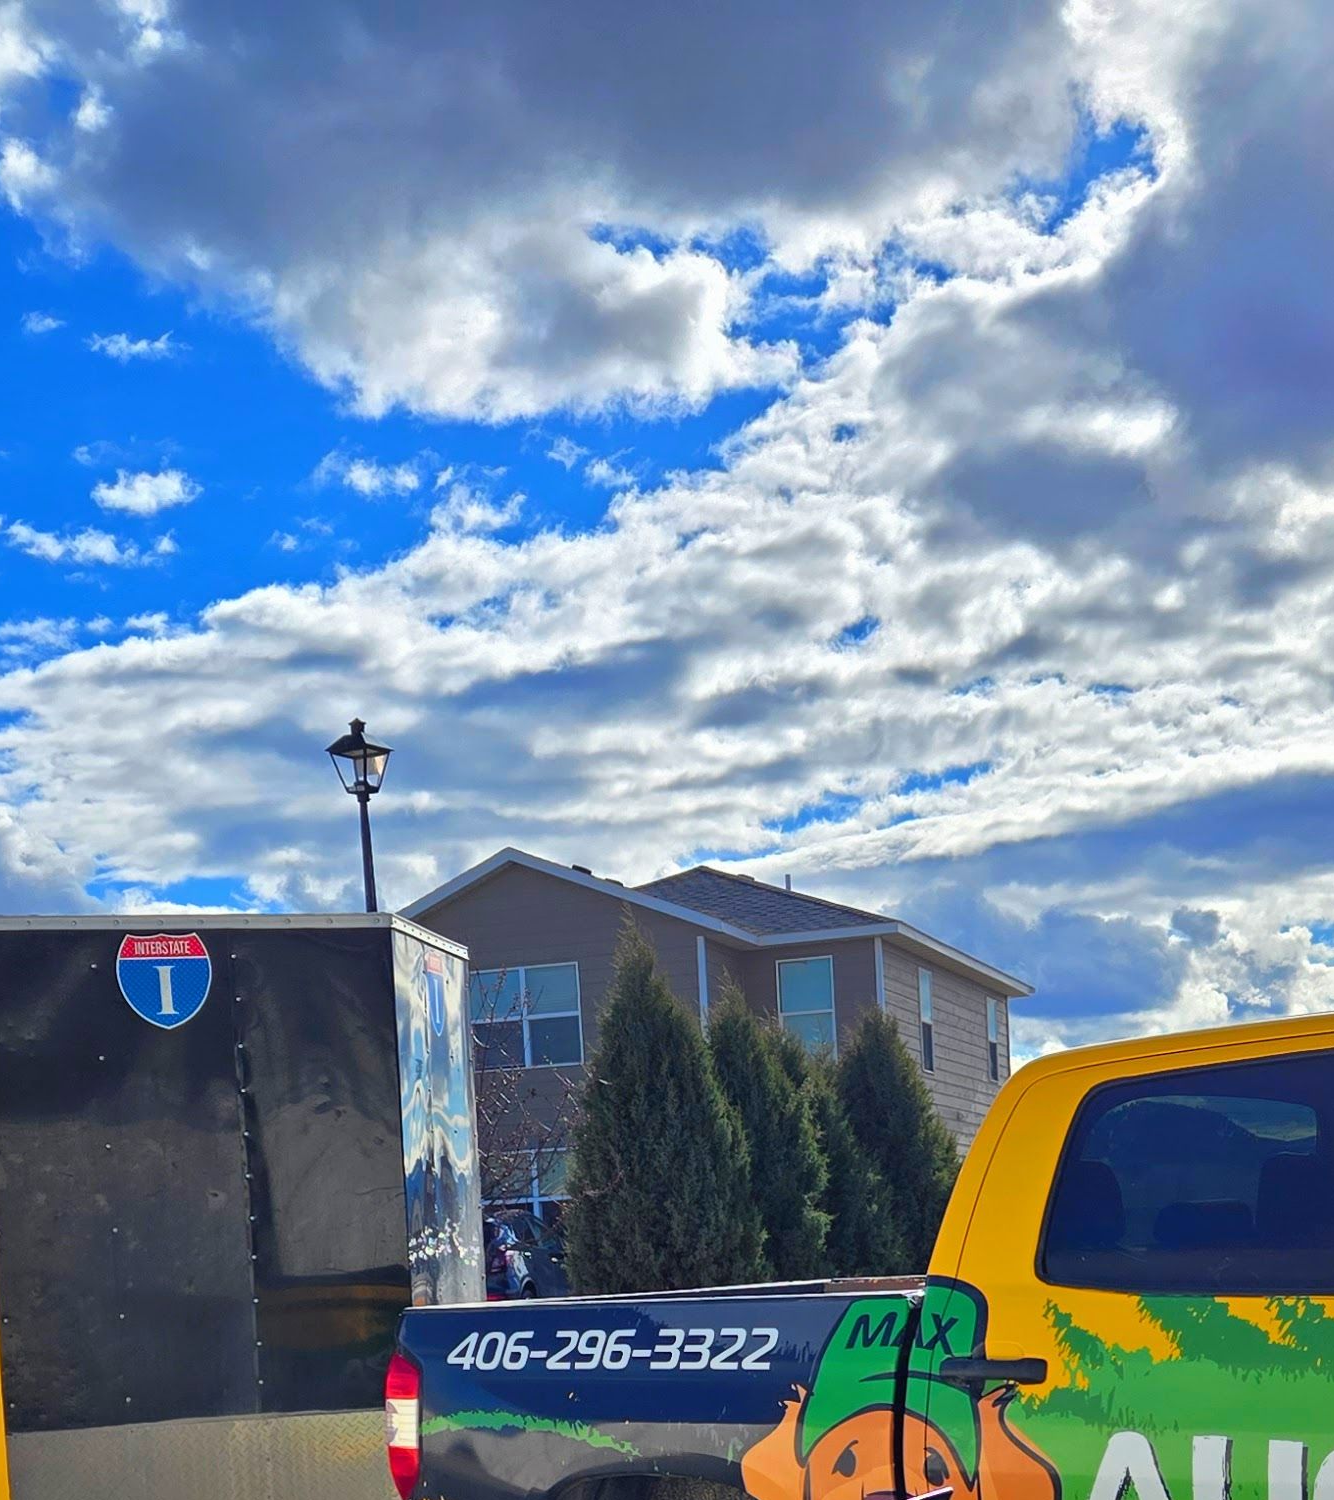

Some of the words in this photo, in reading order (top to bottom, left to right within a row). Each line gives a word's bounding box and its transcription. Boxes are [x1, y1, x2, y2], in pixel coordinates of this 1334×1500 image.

[134, 941, 191, 955] INTERSTATE
[153, 965, 180, 1015] I
[446, 1327, 780, 1371] 406-296-3322
[845, 1311, 960, 1357] MAX
